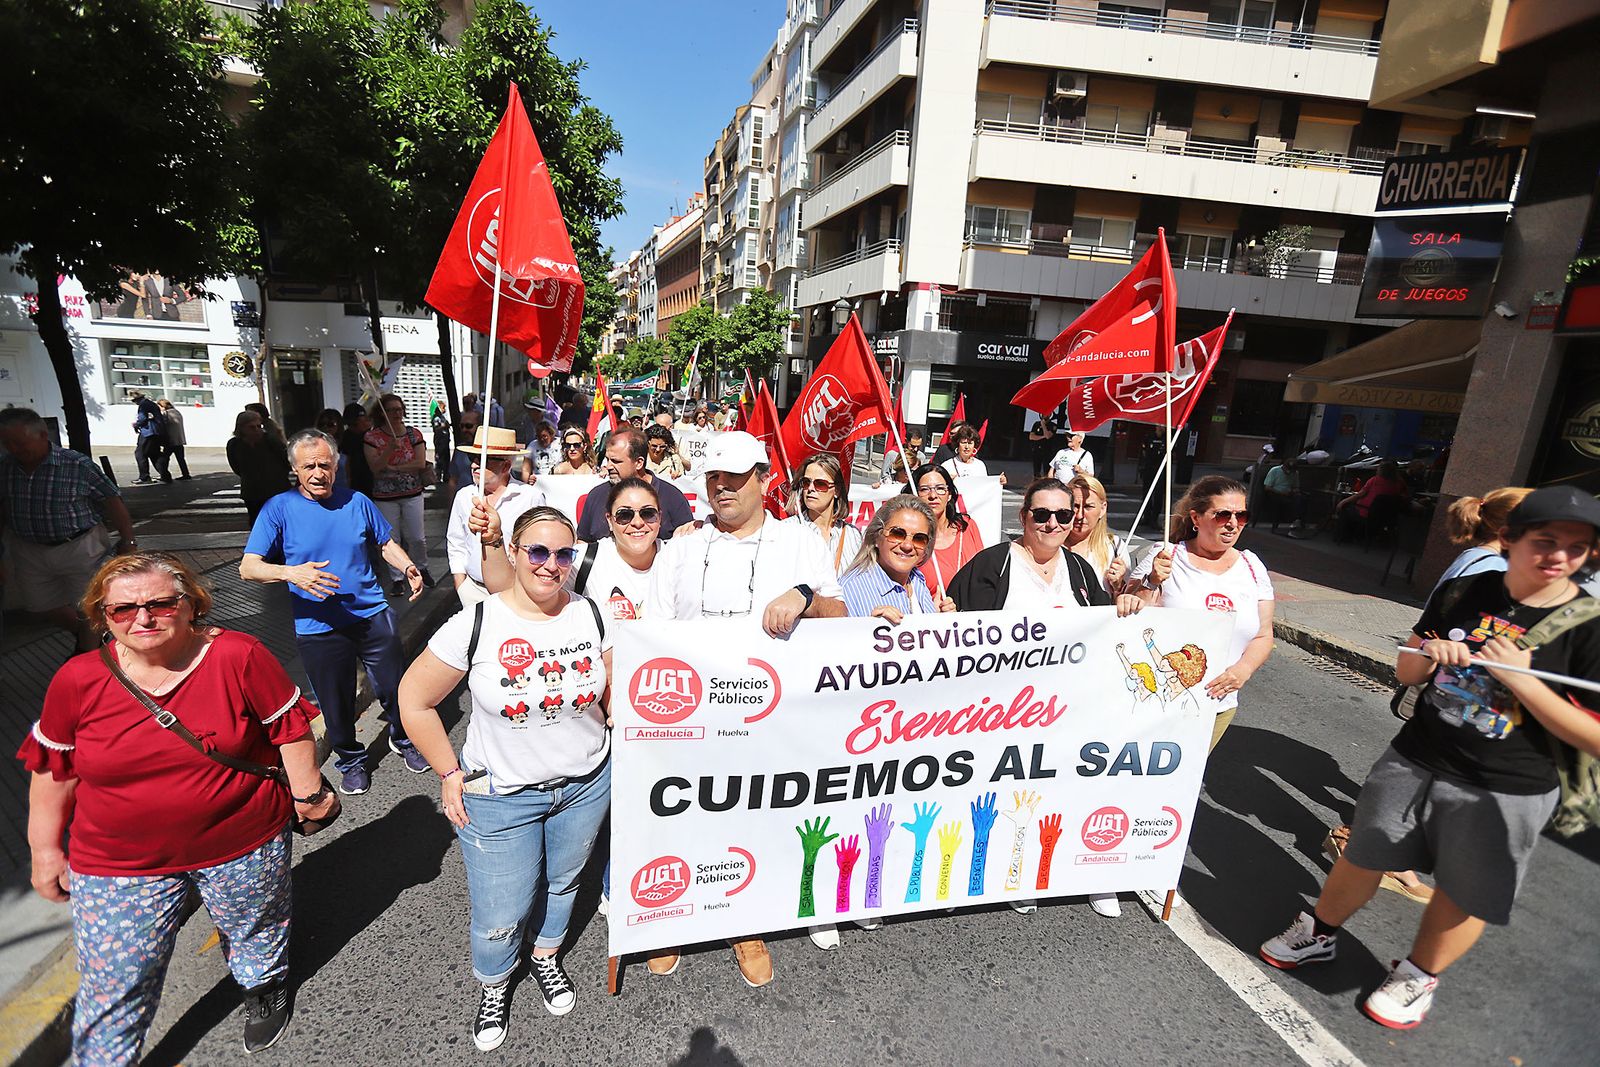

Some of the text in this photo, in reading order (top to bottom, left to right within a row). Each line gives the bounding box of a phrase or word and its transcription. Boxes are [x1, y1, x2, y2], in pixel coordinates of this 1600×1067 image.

[1381, 154, 1509, 205] CHURRERIA
[1409, 232, 1462, 246] SALA
[64, 295, 85, 306] RUIZ
[1377, 287, 1469, 302] DE JUEGOS
[365, 323, 419, 335] AHENA
[977, 353, 995, 361] suelos
[978, 343, 1030, 357] car vall
[1059, 347, 1150, 366] gt-andalucia.com
[803, 379, 843, 441] UGT
[688, 440, 708, 449] TRA
[873, 615, 1047, 654] Servicio de
[501, 643, 531, 657] UGT
[814, 642, 1087, 693] AYUDA A DOMICILIO
[641, 668, 694, 693] UGT
[710, 677, 768, 690] Servicios
[709, 691, 764, 705] Públicos
[845, 686, 1068, 756] Esenciales
[636, 728, 693, 738] Andalucía
[717, 729, 749, 737] Huelva
[650, 741, 1182, 817] CUIDEMOS AL SAD
[1089, 813, 1125, 831] UGT
[1134, 818, 1173, 827] Servicios
[1131, 827, 1168, 837] Públicos
[696, 859, 745, 874] Servicios
[971, 841, 985, 892] ESENCIALES
[639, 862, 684, 888] UGT
[696, 871, 741, 885] Públicos
[869, 855, 881, 898] JORNADAS
[939, 853, 951, 896] CONVENIO
[801, 863, 815, 909] SALARIOS
[704, 901, 731, 911] Huelva
[636, 907, 684, 924] Andalucía
